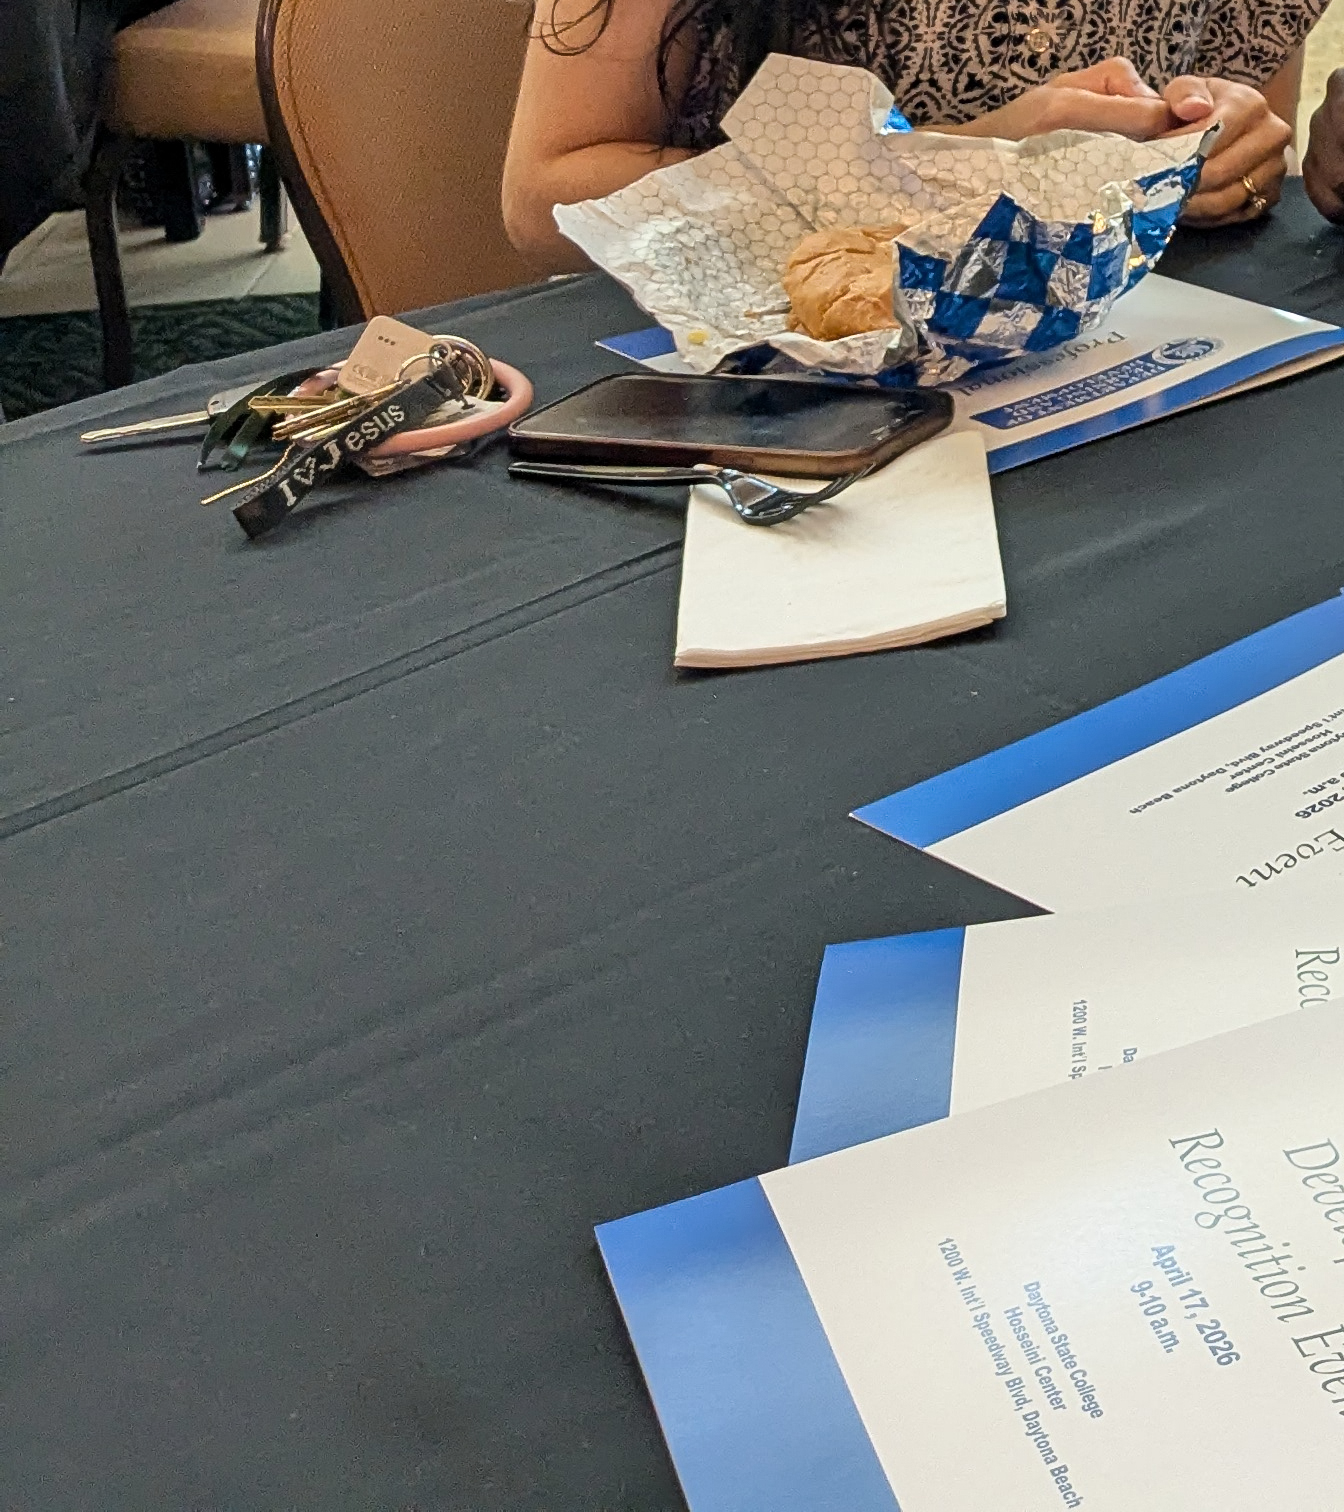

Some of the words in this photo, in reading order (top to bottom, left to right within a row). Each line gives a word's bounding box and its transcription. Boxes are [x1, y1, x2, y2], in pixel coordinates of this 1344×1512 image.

[278, 478, 297, 507] I
[320, 403, 406, 473] Jesus
[1259, 722, 1324, 753] Speedway
[1274, 729, 1333, 759] Hosseini
[1224, 752, 1261, 768] Blvd,
[1229, 757, 1276, 780] Center
[1273, 751, 1311, 770] State
[1172, 767, 1228, 794] Daytona
[1225, 768, 1276, 793] College
[1302, 777, 1341, 795] a.m.
[1129, 792, 1174, 814] Beach
[1072, 999, 1088, 1025] 1200
[1072, 1025, 1087, 1040] W.
[1168, 1127, 1315, 1323] Recognition
[1130, 1280, 1167, 1317] 9-10
[1149, 1317, 1180, 1354] a.m.
[1150, 1245, 1194, 1288] April
[1179, 1288, 1210, 1320] 17,
[1195, 1318, 1241, 1366] 2026
[1003, 1306, 1047, 1366] Hosseini
[1034, 1365, 1067, 1411] Center
[1023, 1281, 1059, 1335] Daytona
[1050, 1333, 1078, 1370] State
[1069, 1369, 1104, 1419] College
[937, 1237, 964, 1268] 1200
[952, 1266, 972, 1286] W.
[972, 1312, 1014, 1377] Speedway
[1005, 1376, 1033, 1412] Blvd,
[1022, 1410, 1058, 1465] Daytona
[1049, 1464, 1084, 1510] Beach
